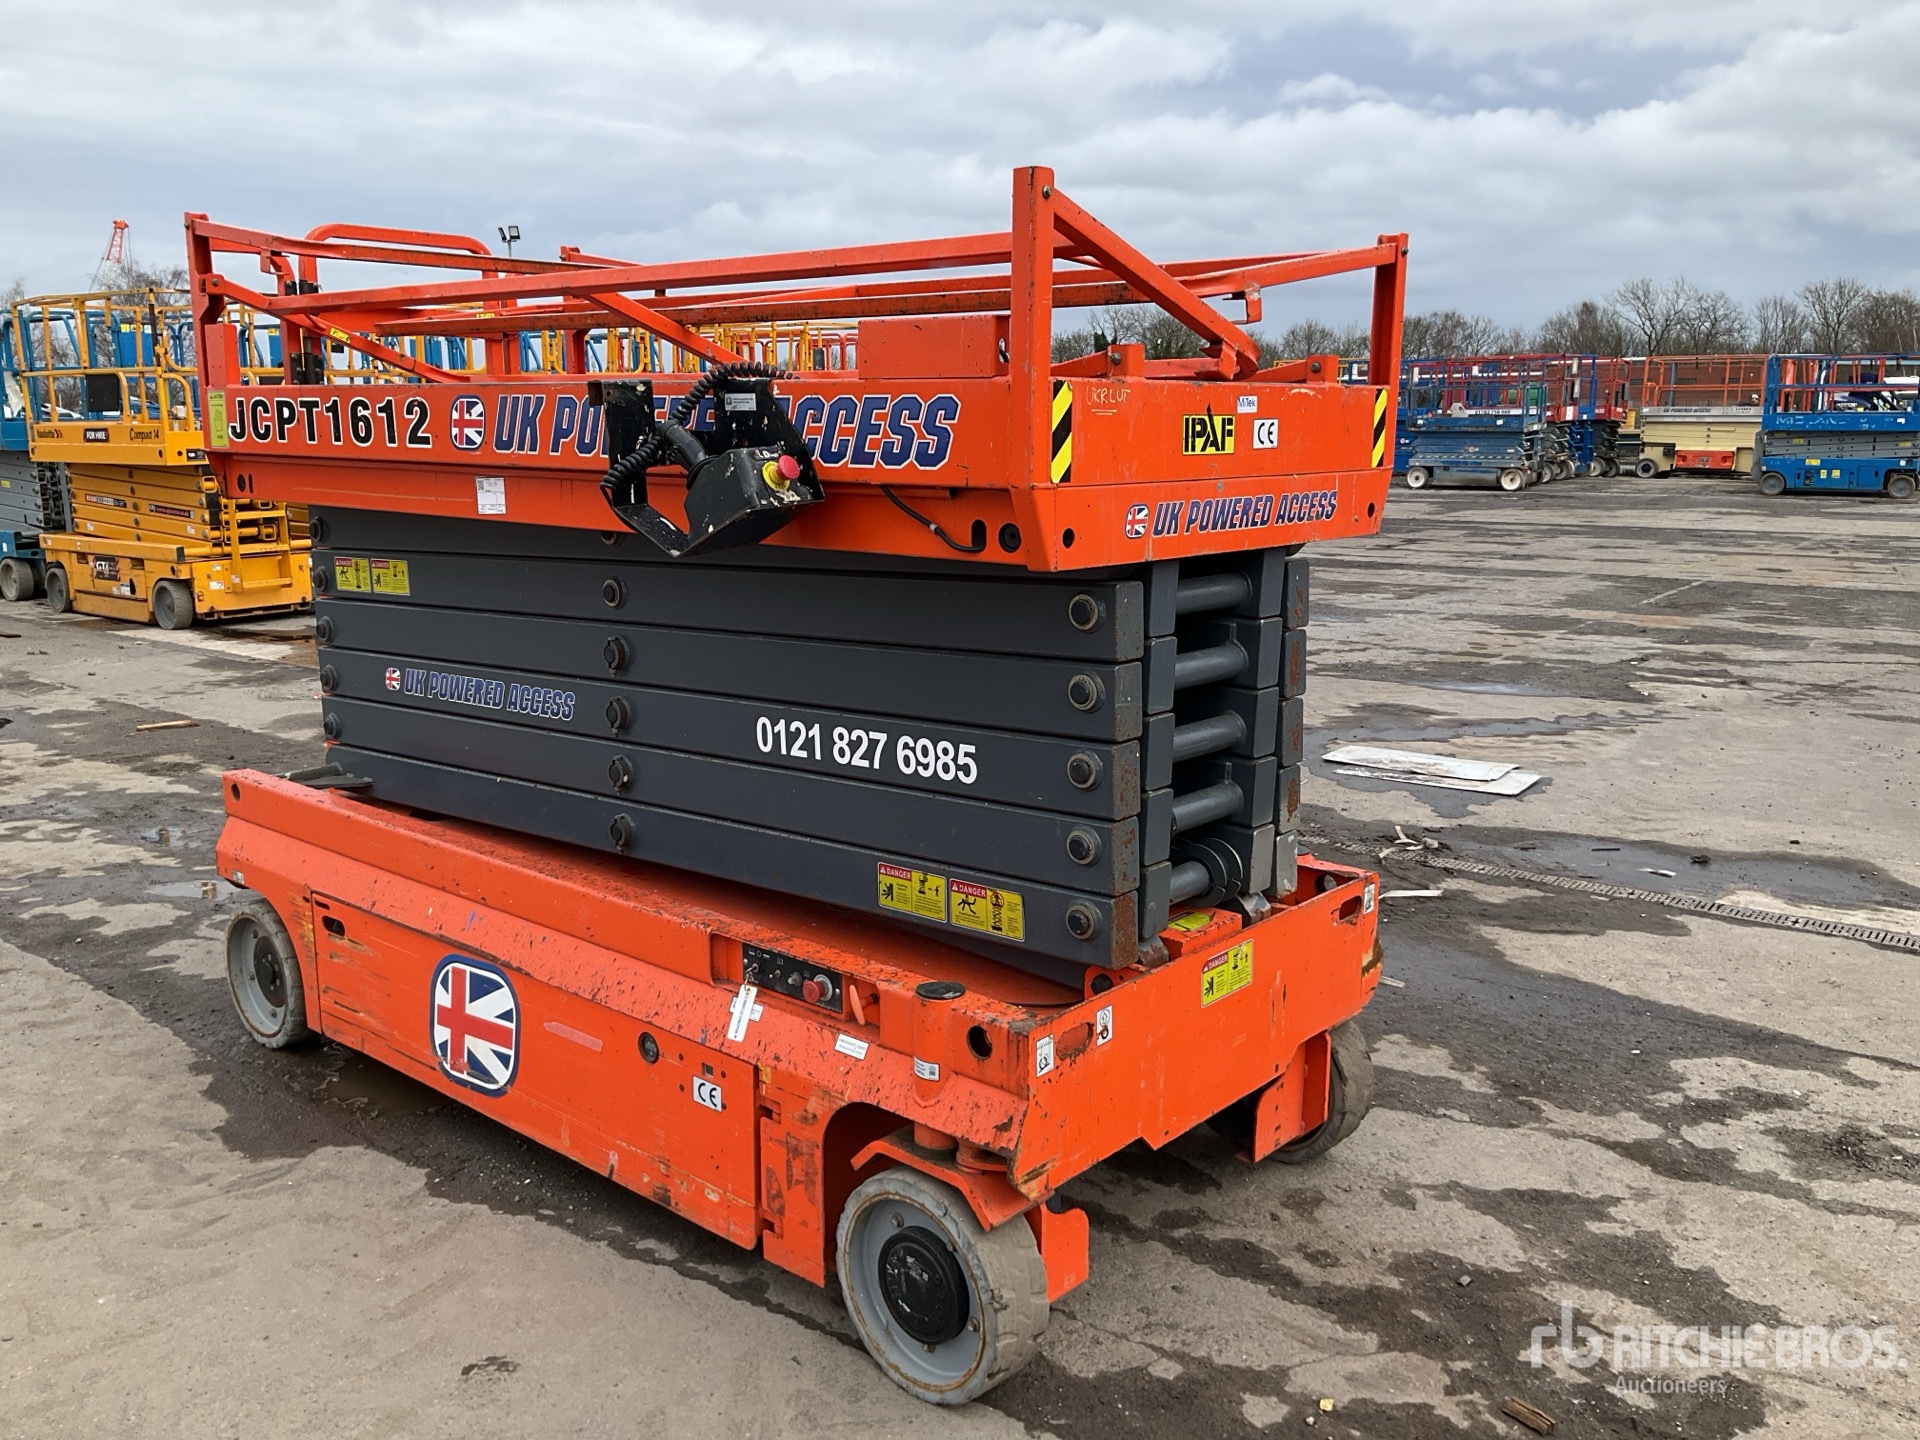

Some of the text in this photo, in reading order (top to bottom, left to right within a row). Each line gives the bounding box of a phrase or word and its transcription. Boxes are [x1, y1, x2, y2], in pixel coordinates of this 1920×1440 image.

[86, 430, 106, 440] FOR HIRE
[129, 427, 160, 443] Compact 14
[229, 397, 432, 448] JCPT1612
[493, 394, 546, 454] UK
[773, 393, 961, 470] CCESS
[1183, 404, 1233, 453] IPAF
[1257, 421, 1275, 445] CE
[1152, 490, 1338, 537] UK POWERED ACCESS
[404, 668, 575, 721] UK POWERED ACCESS
[756, 716, 978, 784] 0121 827 6985
[886, 867, 911, 880] DANGER
[959, 884, 986, 897] DANGER
[1208, 954, 1228, 969] DANGER
[697, 1082, 718, 1107] CE
